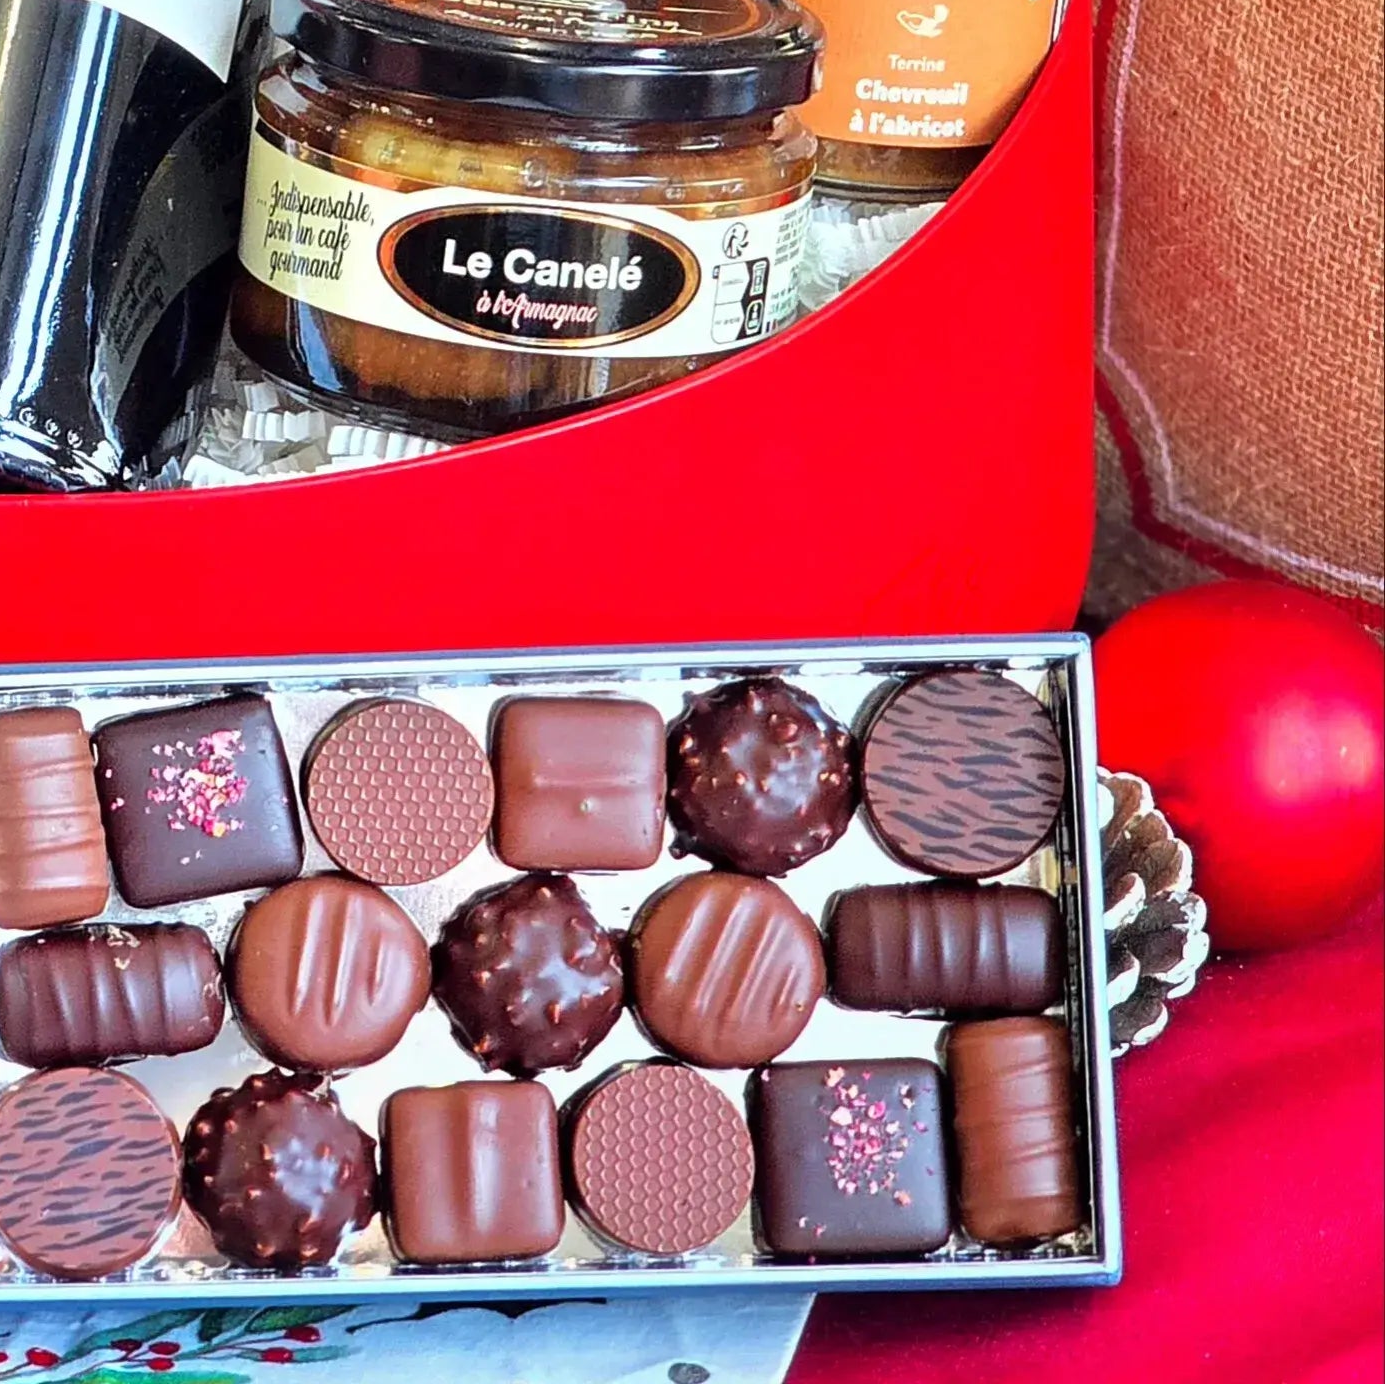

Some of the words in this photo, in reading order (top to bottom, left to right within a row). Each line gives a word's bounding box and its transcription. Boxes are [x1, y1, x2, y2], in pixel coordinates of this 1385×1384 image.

[888, 53, 947, 73] Terrine
[855, 77, 970, 106] Chevreuil
[849, 108, 865, 133] à
[869, 112, 967, 138] l'abricot
[268, 180, 374, 228] Indispensable,
[264, 218, 293, 248] pour
[295, 224, 316, 246] un
[318, 222, 351, 260] café
[269, 250, 344, 281] gourmand
[443, 238, 493, 279] Le
[503, 248, 643, 291] Canelé
[476, 290, 492, 314] à
